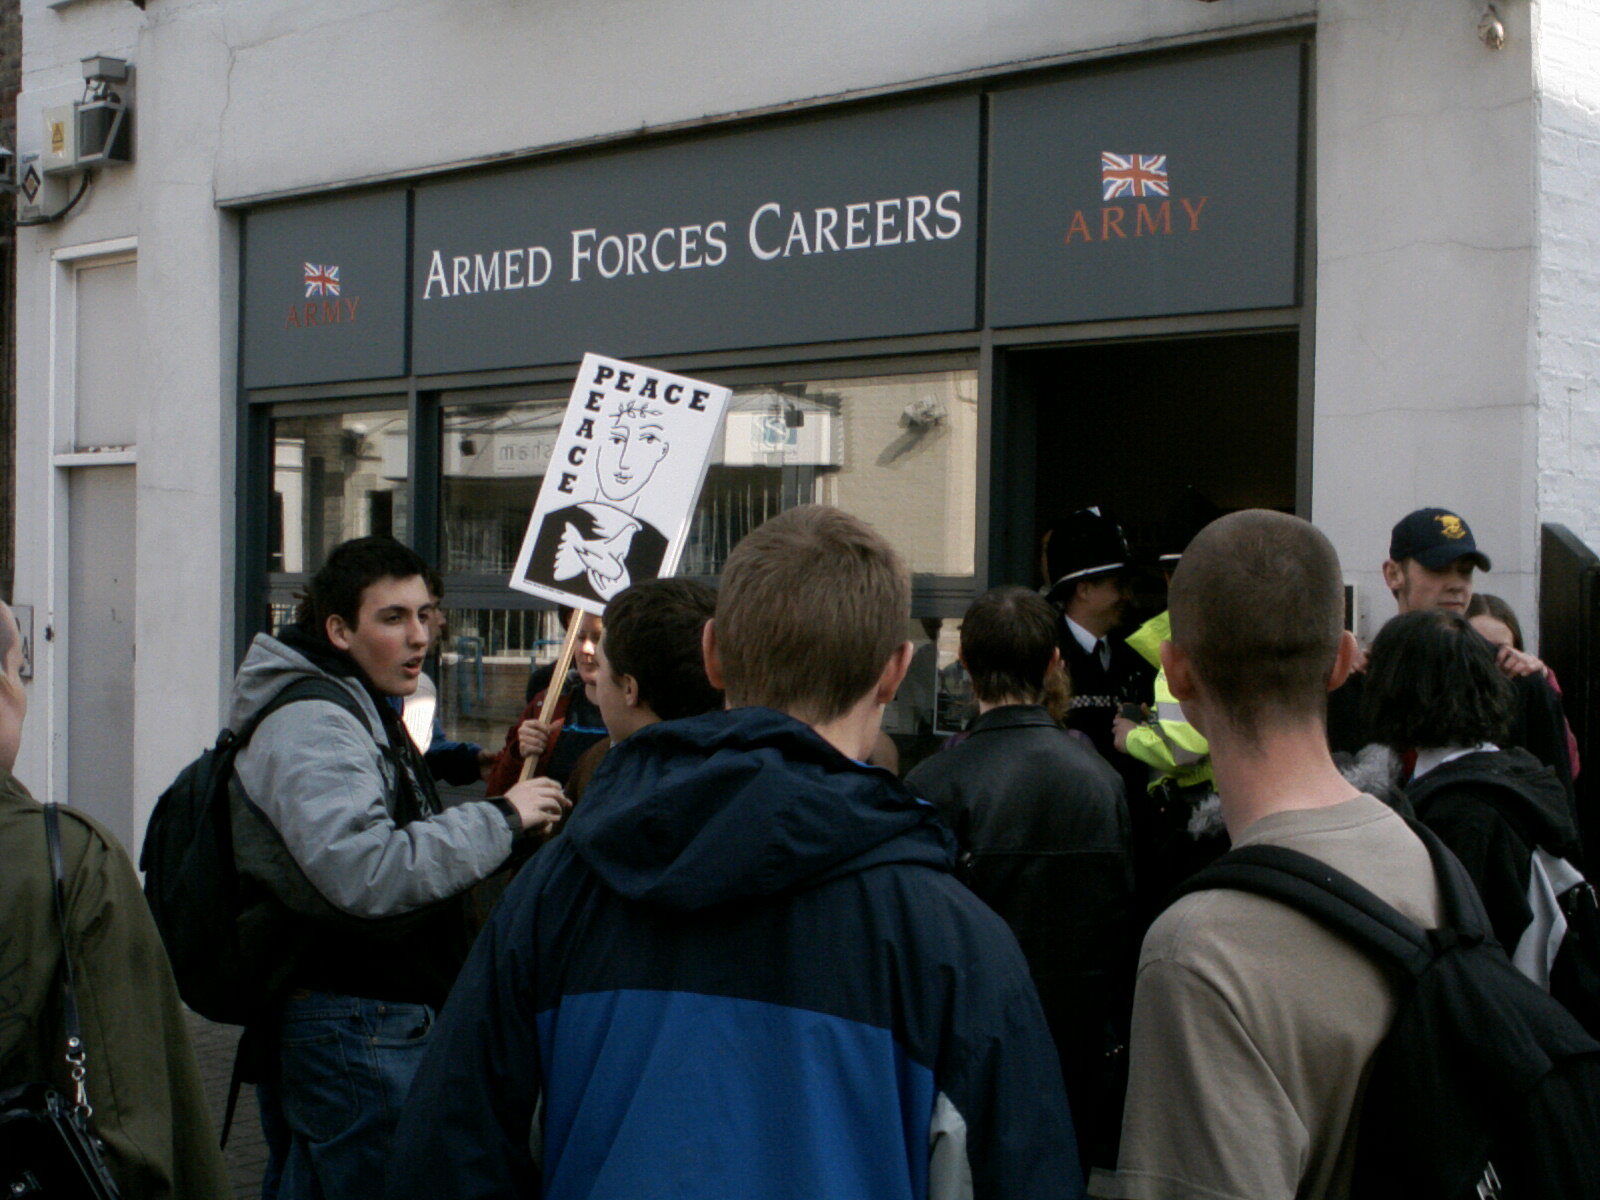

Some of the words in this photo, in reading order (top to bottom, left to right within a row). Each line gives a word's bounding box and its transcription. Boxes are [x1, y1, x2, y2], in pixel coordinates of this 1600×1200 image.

[1064, 196, 1208, 244] ARMY
[423, 246, 552, 299] ARMED
[570, 221, 727, 282] FORCES
[749, 190, 962, 260] CAREERS
[285, 296, 360, 329] ARMY
[593, 365, 710, 412] PEACE
